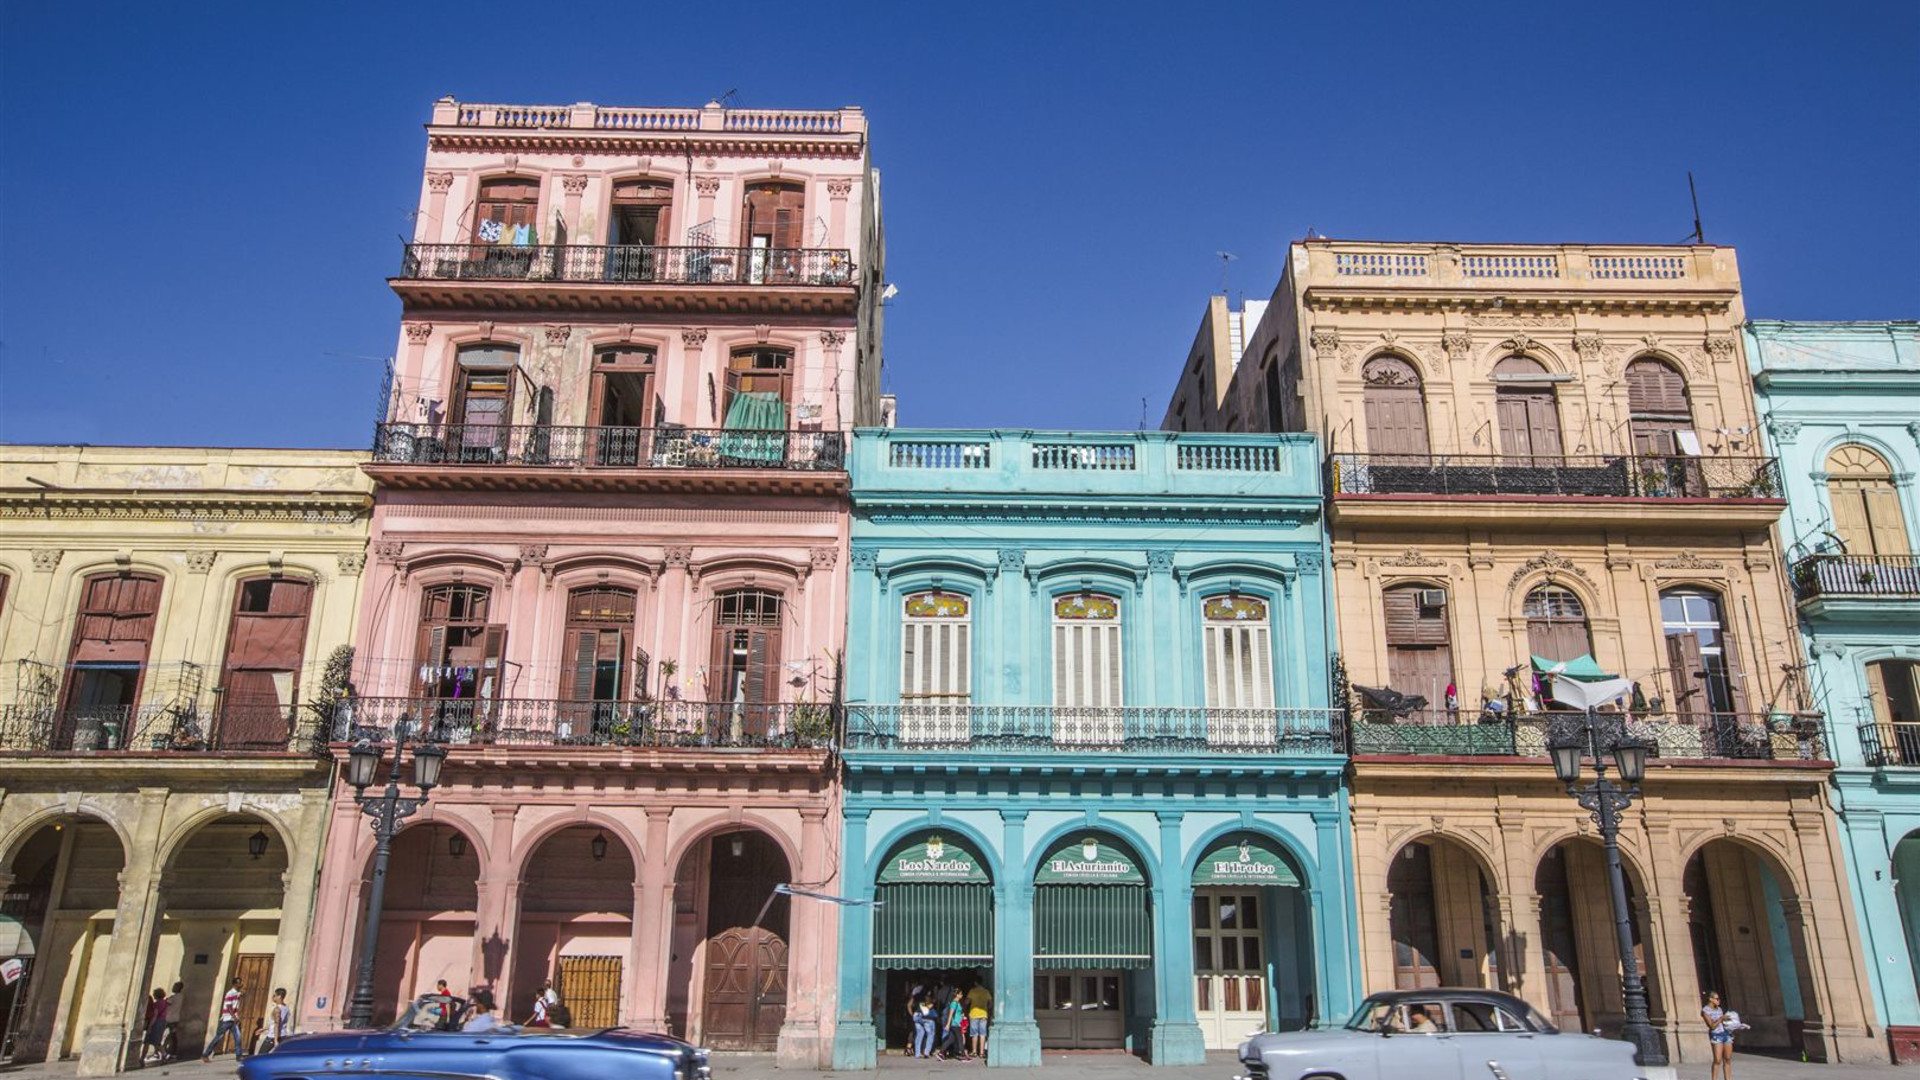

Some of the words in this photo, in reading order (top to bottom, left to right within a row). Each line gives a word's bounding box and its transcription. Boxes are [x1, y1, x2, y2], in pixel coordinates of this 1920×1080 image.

[899, 859, 922, 871] Los
[923, 859, 971, 871] Nardos
[1051, 860, 1066, 872] El
[1066, 860, 1130, 873] Asturianito
[1214, 861, 1229, 873] El
[1230, 861, 1275, 874] Trofeo
